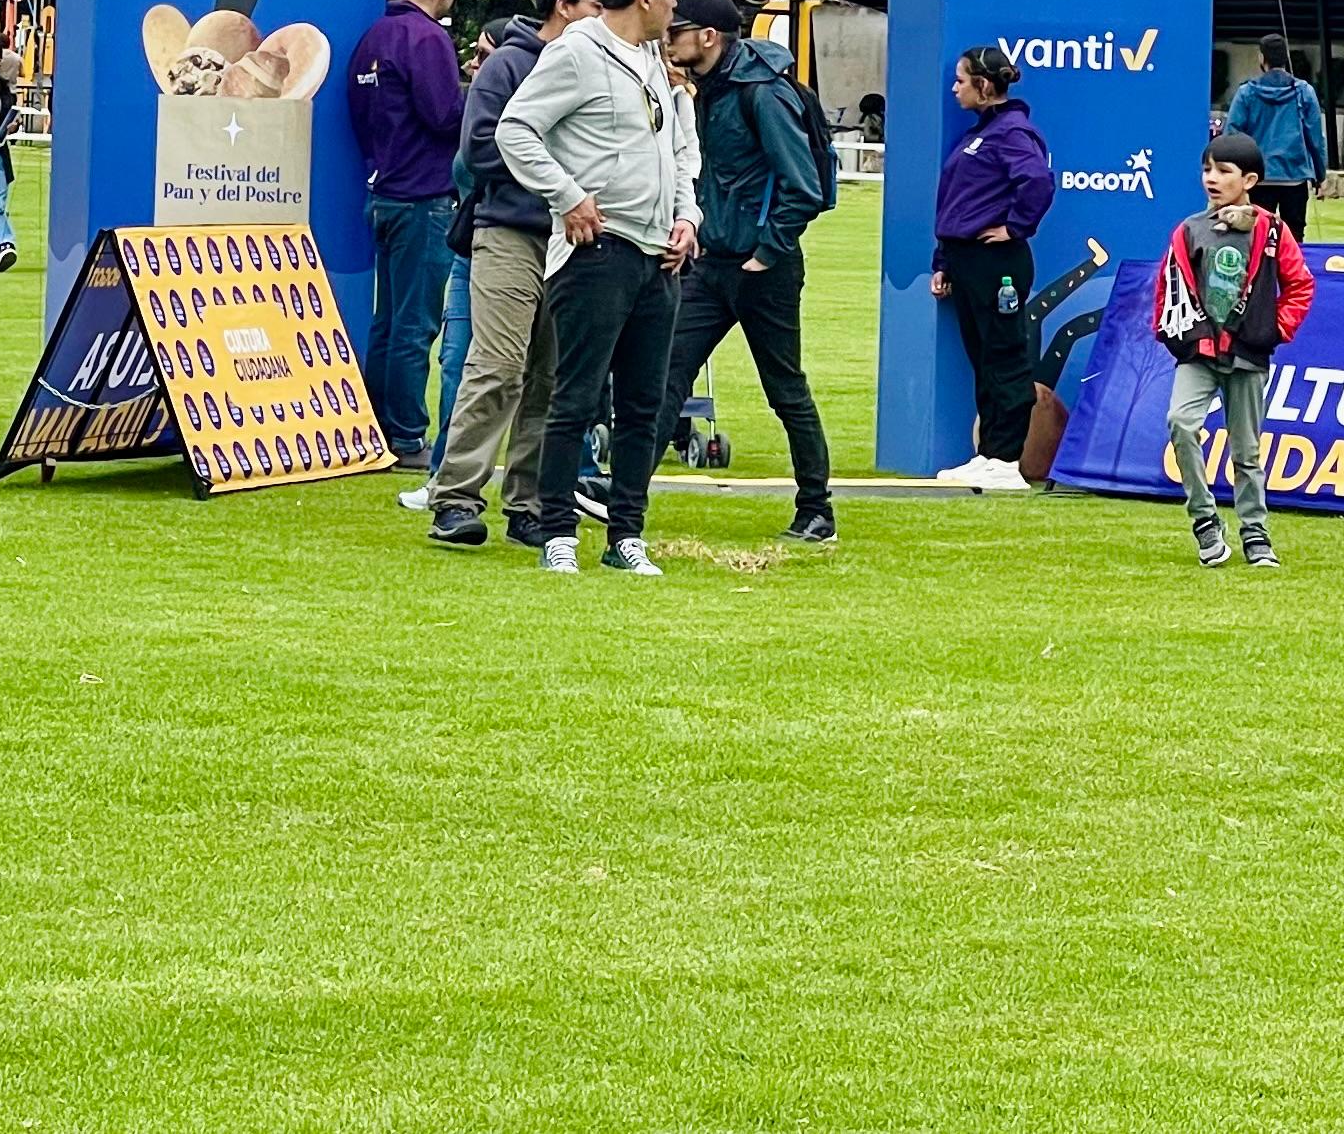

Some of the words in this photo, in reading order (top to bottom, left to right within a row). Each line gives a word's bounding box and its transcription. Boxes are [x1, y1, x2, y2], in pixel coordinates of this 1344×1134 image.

[997, 31, 1114, 71] vanti
[186, 163, 252, 183] Festival
[256, 166, 280, 183] del
[163, 183, 194, 202] Pan
[199, 190, 209, 206] y
[216, 184, 241, 202] del
[246, 185, 302, 204] Postre
[233, 355, 294, 382] CIUDADANA
